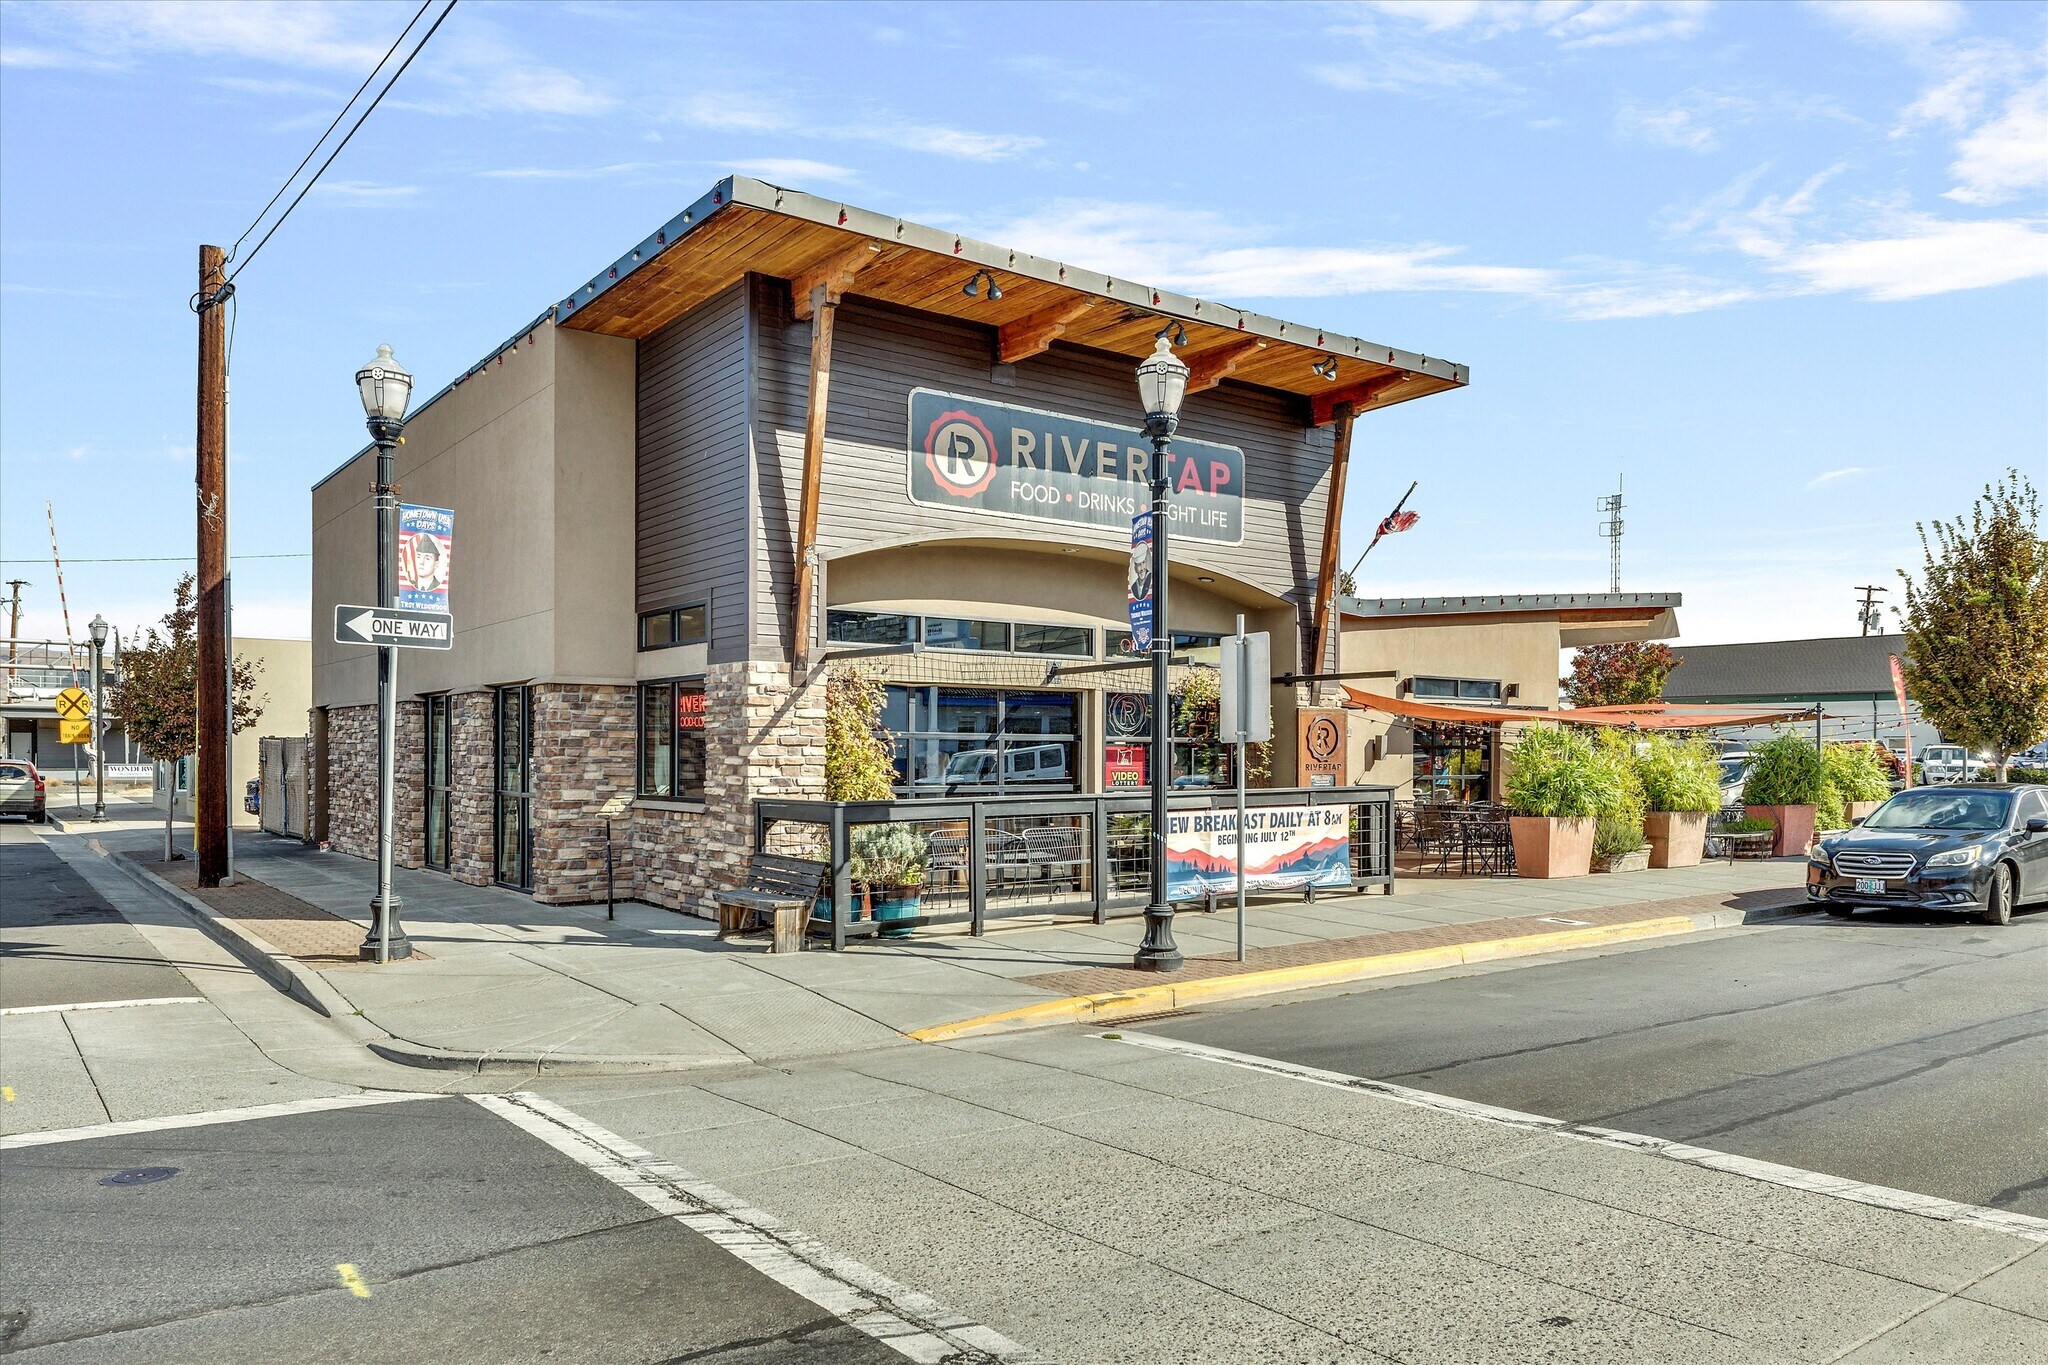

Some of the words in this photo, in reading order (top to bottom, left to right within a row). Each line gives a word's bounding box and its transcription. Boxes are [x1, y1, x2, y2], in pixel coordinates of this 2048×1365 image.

[1011, 481, 1060, 504] FOOD
[1079, 491, 1135, 515] DRINKS
[1166, 503, 1197, 523] GHT
[1200, 509, 1228, 528] LIFE
[416, 520, 436, 531] DAYS
[372, 619, 403, 635] ONE
[409, 622, 440, 637] WAY
[59, 700, 67, 709] R
[81, 700, 89, 709] R
[1111, 771, 1139, 781] VIDEO
[1194, 813, 1266, 832] BREAKAST
[1270, 811, 1303, 829] DAILY
[1307, 811, 1321, 827] AT
[1217, 832, 1258, 846] BEGINING
[1260, 831, 1277, 842] JULY
[1280, 830, 1296, 842] 12TH
